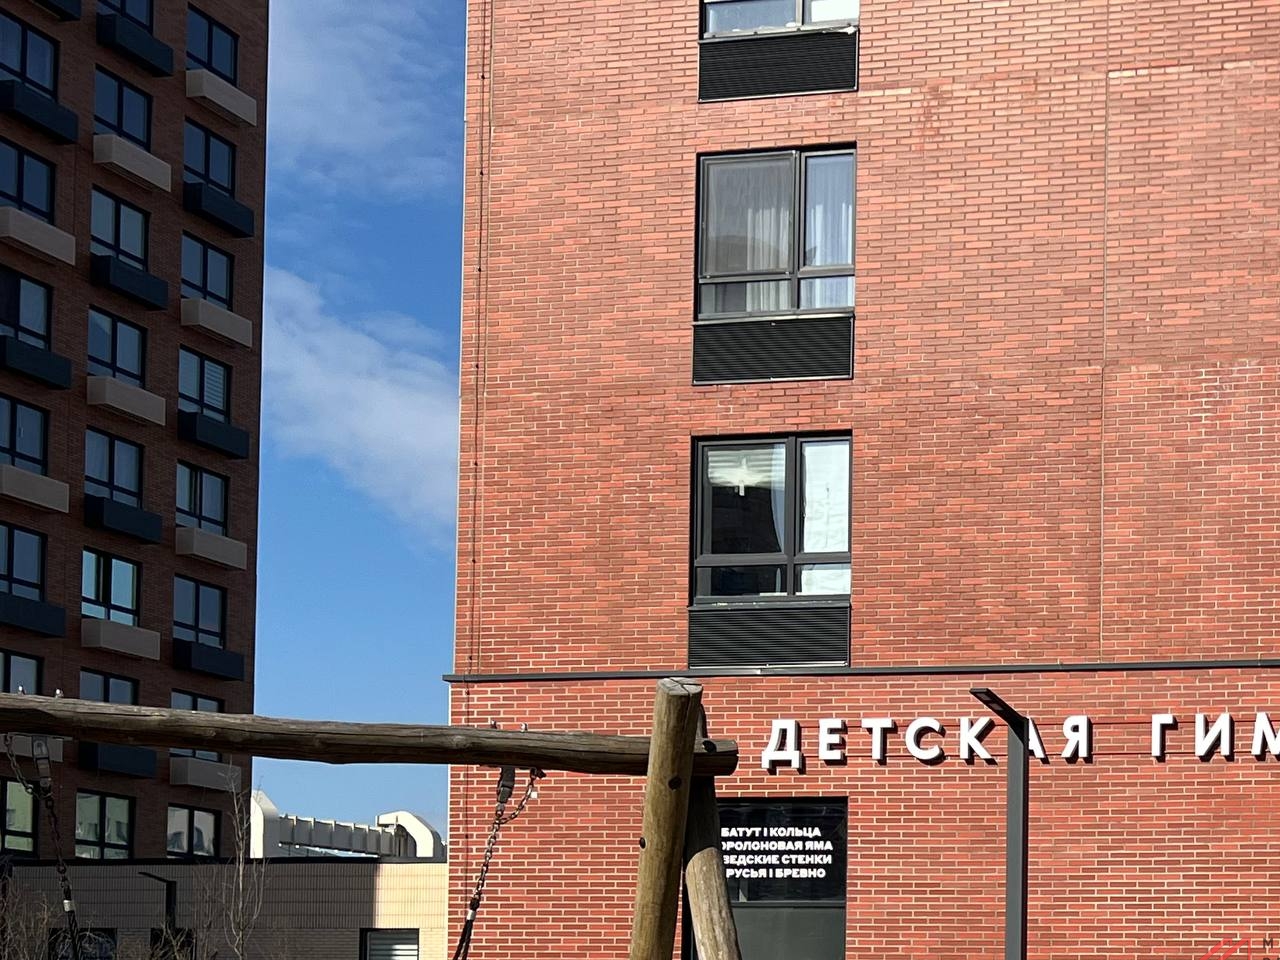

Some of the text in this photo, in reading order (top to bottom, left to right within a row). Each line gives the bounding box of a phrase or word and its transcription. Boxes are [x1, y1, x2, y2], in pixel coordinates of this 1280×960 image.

[720, 827, 762, 838] БАТУТ
[769, 826, 822, 839] КОЛЬЦА
[721, 840, 834, 851] РОЛОНОВАЯ ЯМА
[723, 854, 833, 867] ВЕДСКИЕ СТЕНКИ
[725, 868, 768, 879] РУСЬЯ
[775, 867, 827, 879] БРЕВНО
